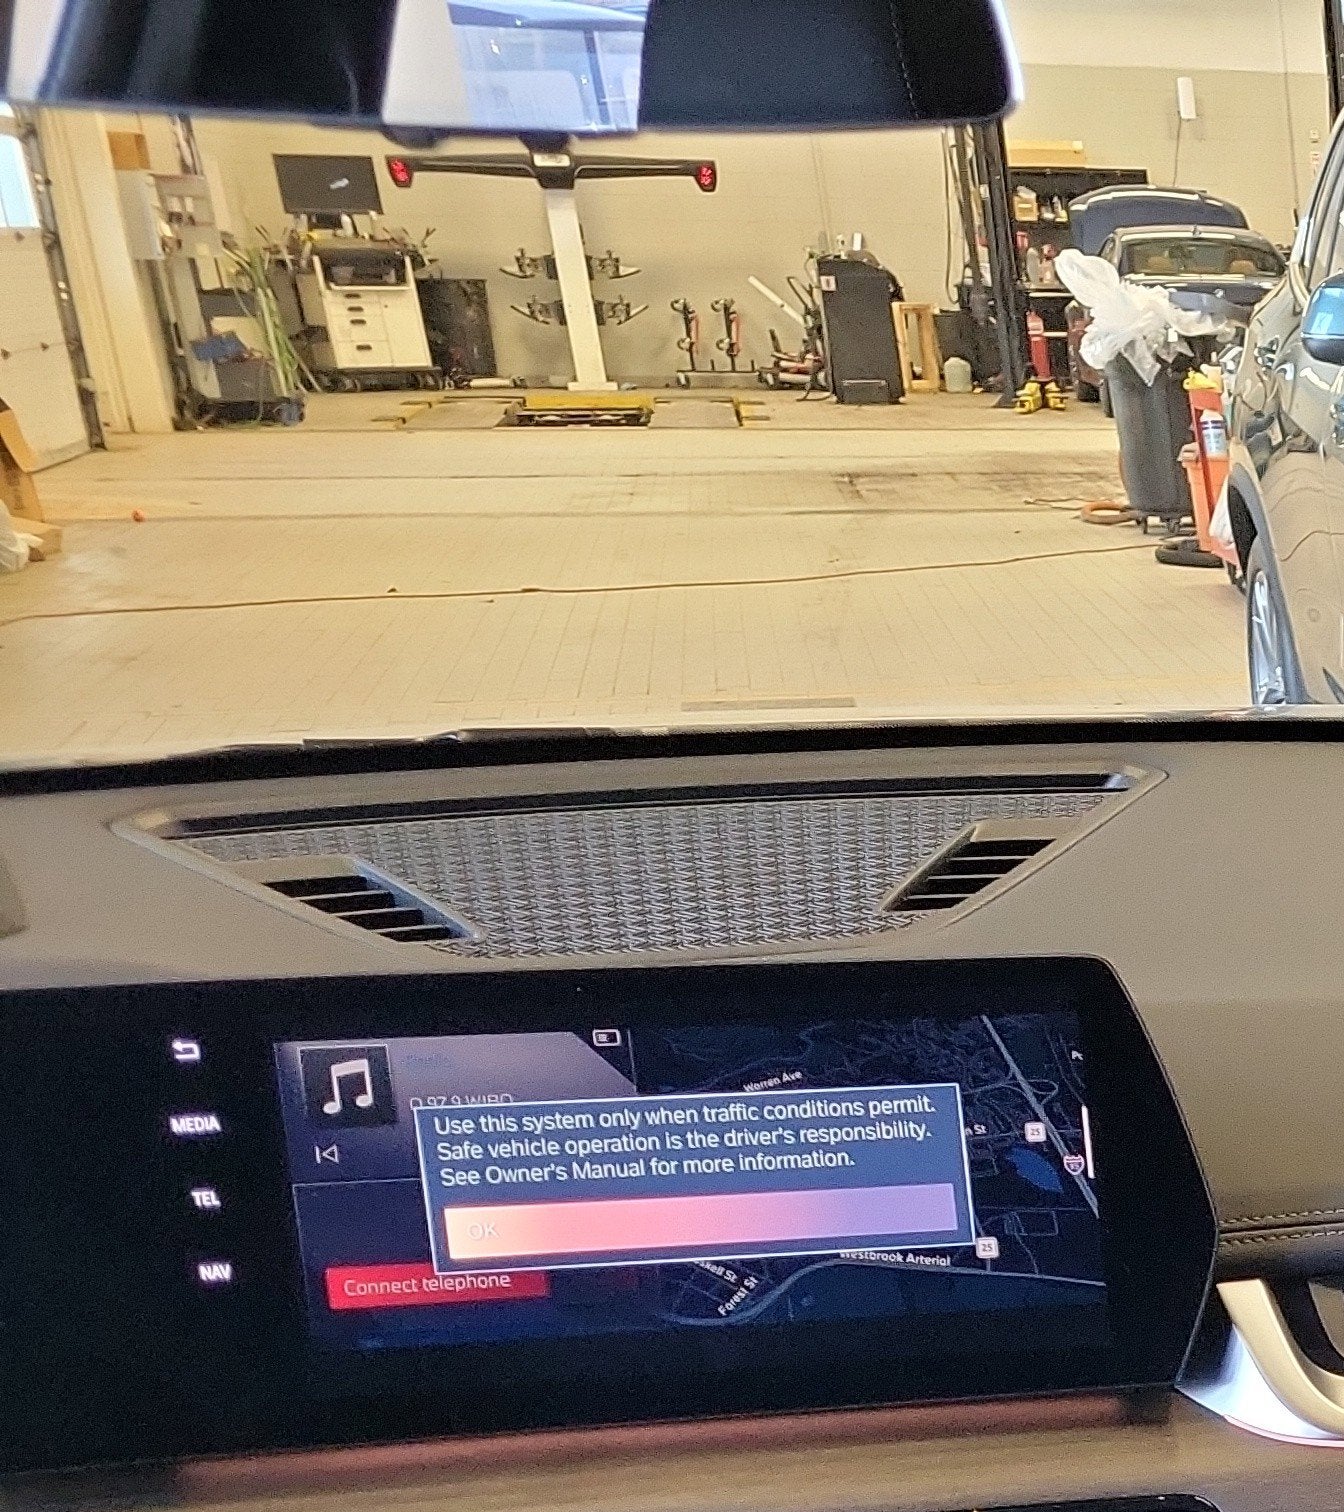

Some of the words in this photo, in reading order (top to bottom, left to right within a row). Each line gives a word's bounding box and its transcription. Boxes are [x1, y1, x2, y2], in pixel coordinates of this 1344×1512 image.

[170, 1114, 222, 1134] MEDIA
[433, 1115, 475, 1135] Use
[479, 1113, 519, 1132] this
[521, 1111, 594, 1135] system
[598, 1108, 640, 1131] only
[644, 1105, 698, 1125] when
[702, 1102, 759, 1122] traffic
[763, 1097, 865, 1119] conditions
[868, 1094, 936, 1118] permit.
[436, 1141, 483, 1160] Safe
[487, 1137, 560, 1158] vehicle
[563, 1132, 660, 1157] operation
[665, 1131, 683, 1149] is
[685, 1129, 720, 1148] the
[723, 1126, 796, 1147] driver's
[799, 1119, 932, 1146] responsibility.
[440, 1167, 481, 1186] See
[485, 1162, 568, 1184] Owner's
[571, 1158, 646, 1180] Manual
[649, 1157, 677, 1175] for
[683, 1158, 735, 1174] more
[738, 1148, 855, 1171] information.
[192, 1187, 221, 1208] TEL
[466, 1222, 500, 1240] OK
[905, 1253, 951, 1266] Arterial
[198, 1262, 232, 1282] NAV
[343, 1277, 418, 1297] Connect
[422, 1274, 511, 1293] telephone
